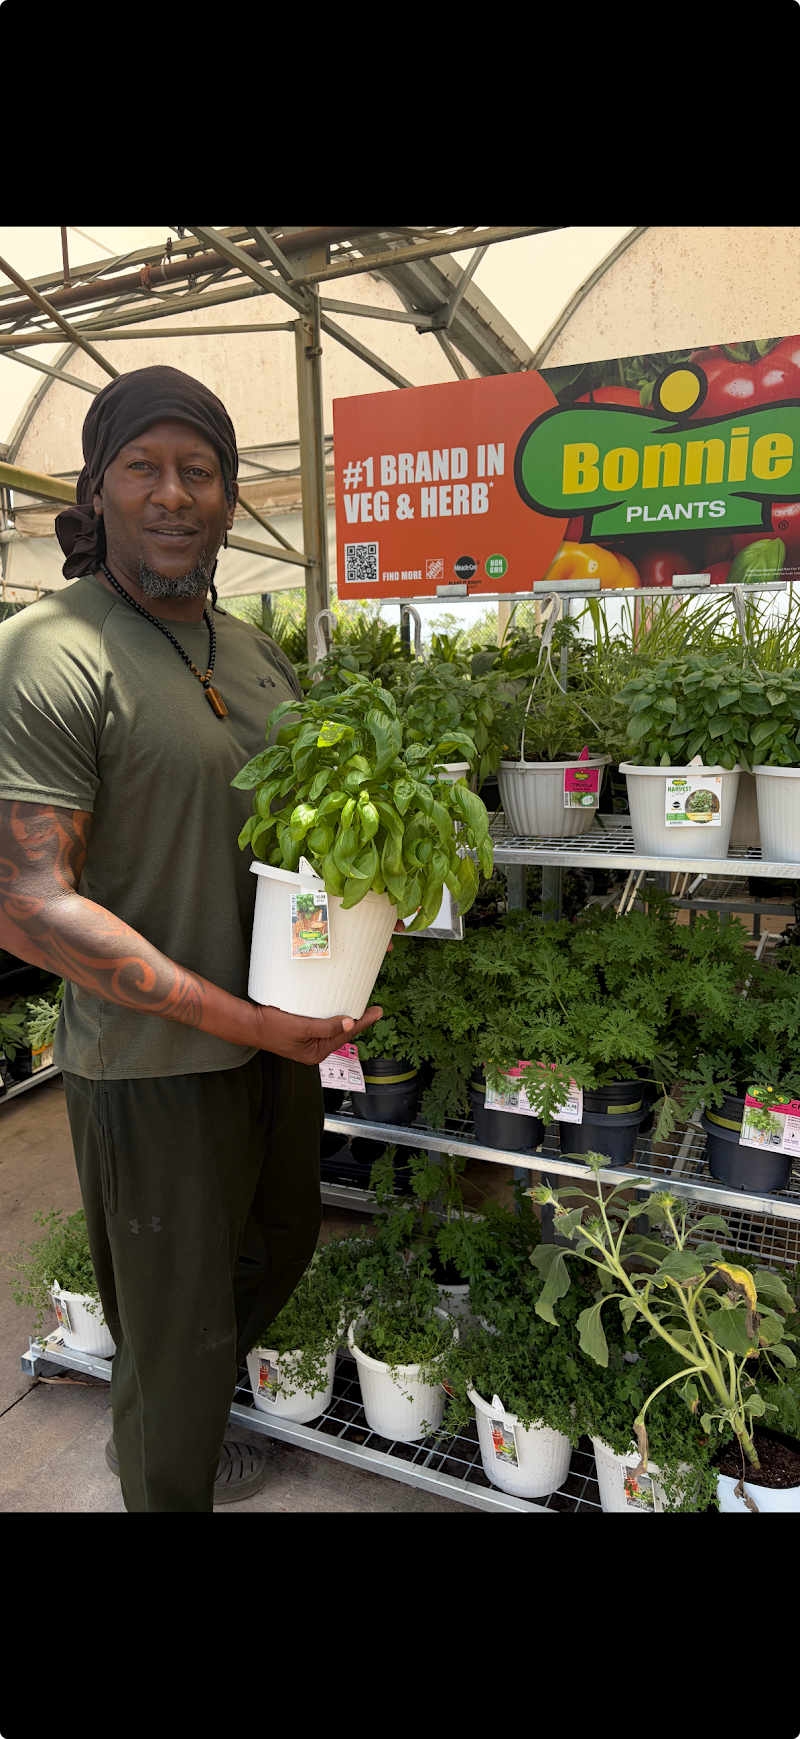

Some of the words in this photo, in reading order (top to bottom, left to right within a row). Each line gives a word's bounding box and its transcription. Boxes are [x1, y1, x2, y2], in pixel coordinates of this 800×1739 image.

[343, 456, 374, 490] #1
[380, 446, 468, 486] BRAND
[477, 442, 505, 477] IN
[562, 426, 794, 495] Bonnie
[343, 490, 390, 524] VEG
[395, 493, 415, 520] &
[626, 500, 726, 523] PLANTS
[489, 559, 503, 567] NON
[489, 566, 503, 574] GMO
[382, 571, 400, 582] FIND
[401, 570, 423, 581] MORE
